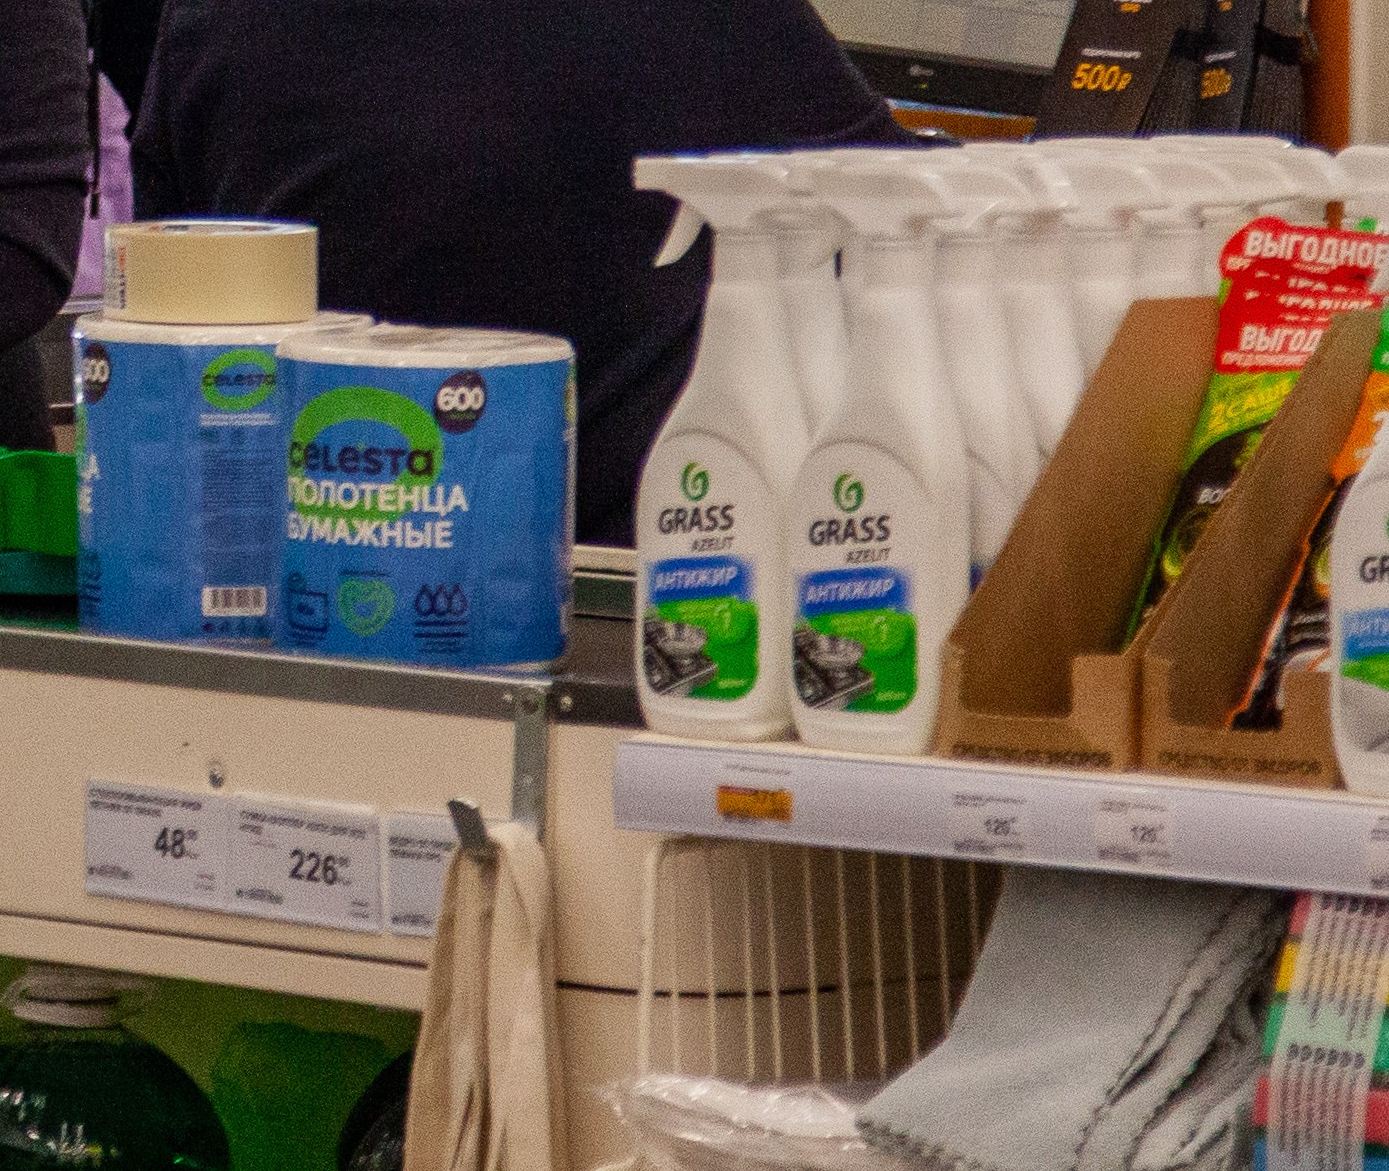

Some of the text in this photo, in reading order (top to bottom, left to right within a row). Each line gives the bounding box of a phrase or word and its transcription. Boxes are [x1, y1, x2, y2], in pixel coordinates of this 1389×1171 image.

[1239, 324, 1323, 353] ВЫГОД
[437, 386, 486, 412] 600
[288, 476, 470, 517] ПОЛОТЕНЦА
[287, 512, 454, 550] БУМАЖНЫЕ
[658, 504, 735, 535] GRASS
[809, 515, 891, 547] GRASS
[288, 849, 339, 886] 226
